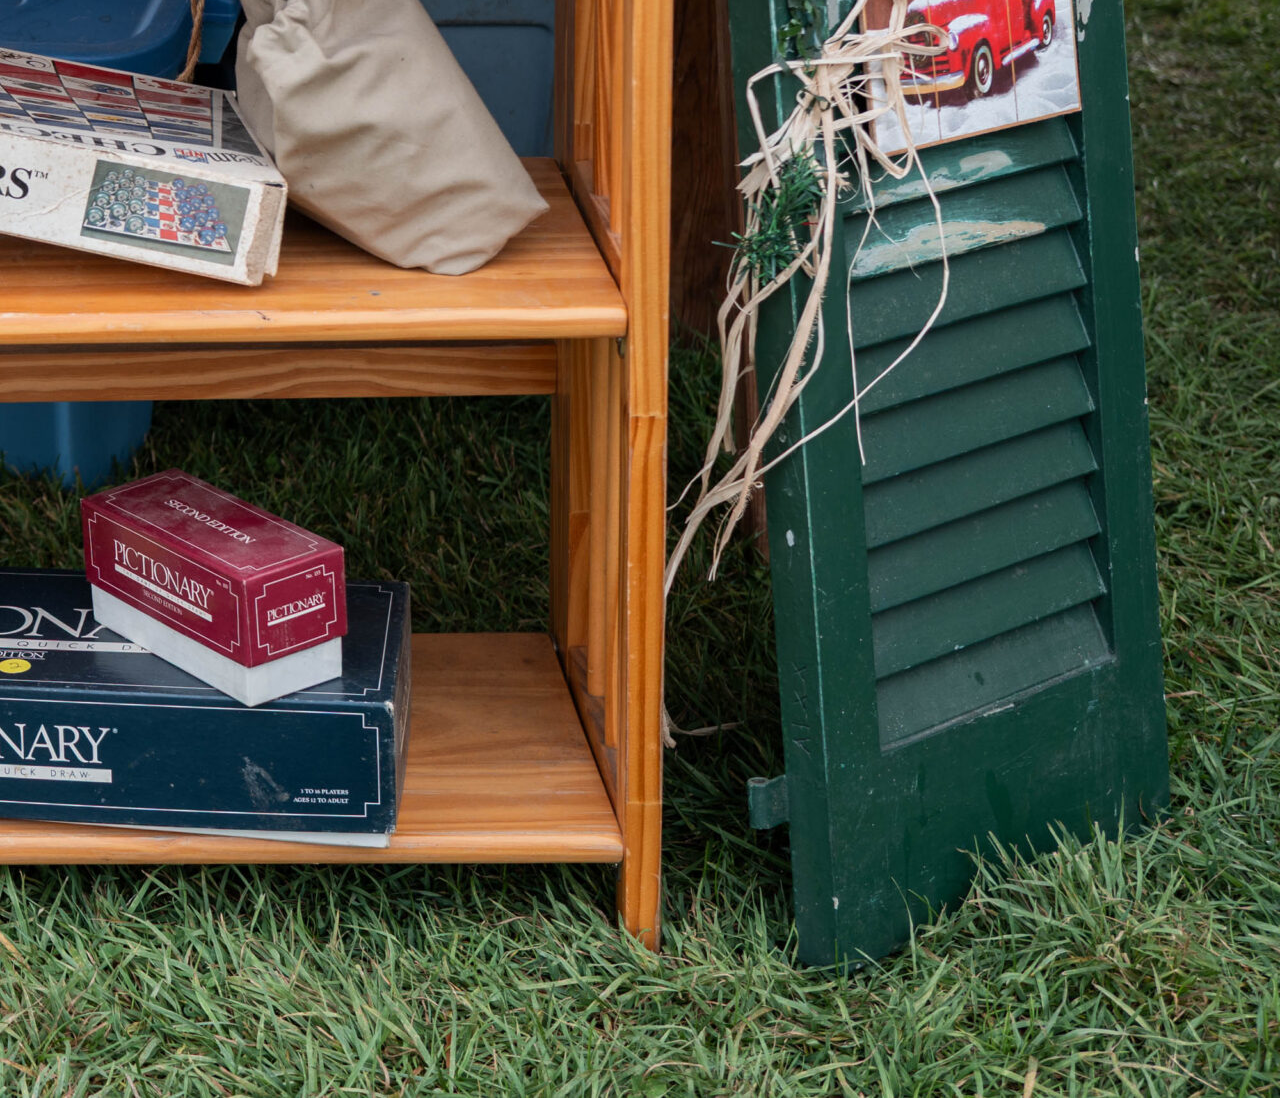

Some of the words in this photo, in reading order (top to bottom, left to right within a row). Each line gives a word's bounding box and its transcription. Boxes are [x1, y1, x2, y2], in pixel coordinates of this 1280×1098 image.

[164, 499, 211, 523] SECOND
[207, 516, 257, 545] EDITION
[114, 539, 211, 610] PICTIONARY
[143, 589, 163, 605] SECOND
[163, 599, 183, 616] EDITION
[267, 592, 326, 622] PICTIONARY
[17, 640, 95, 650] QUICK
[50, 768, 89, 779] DRAW
